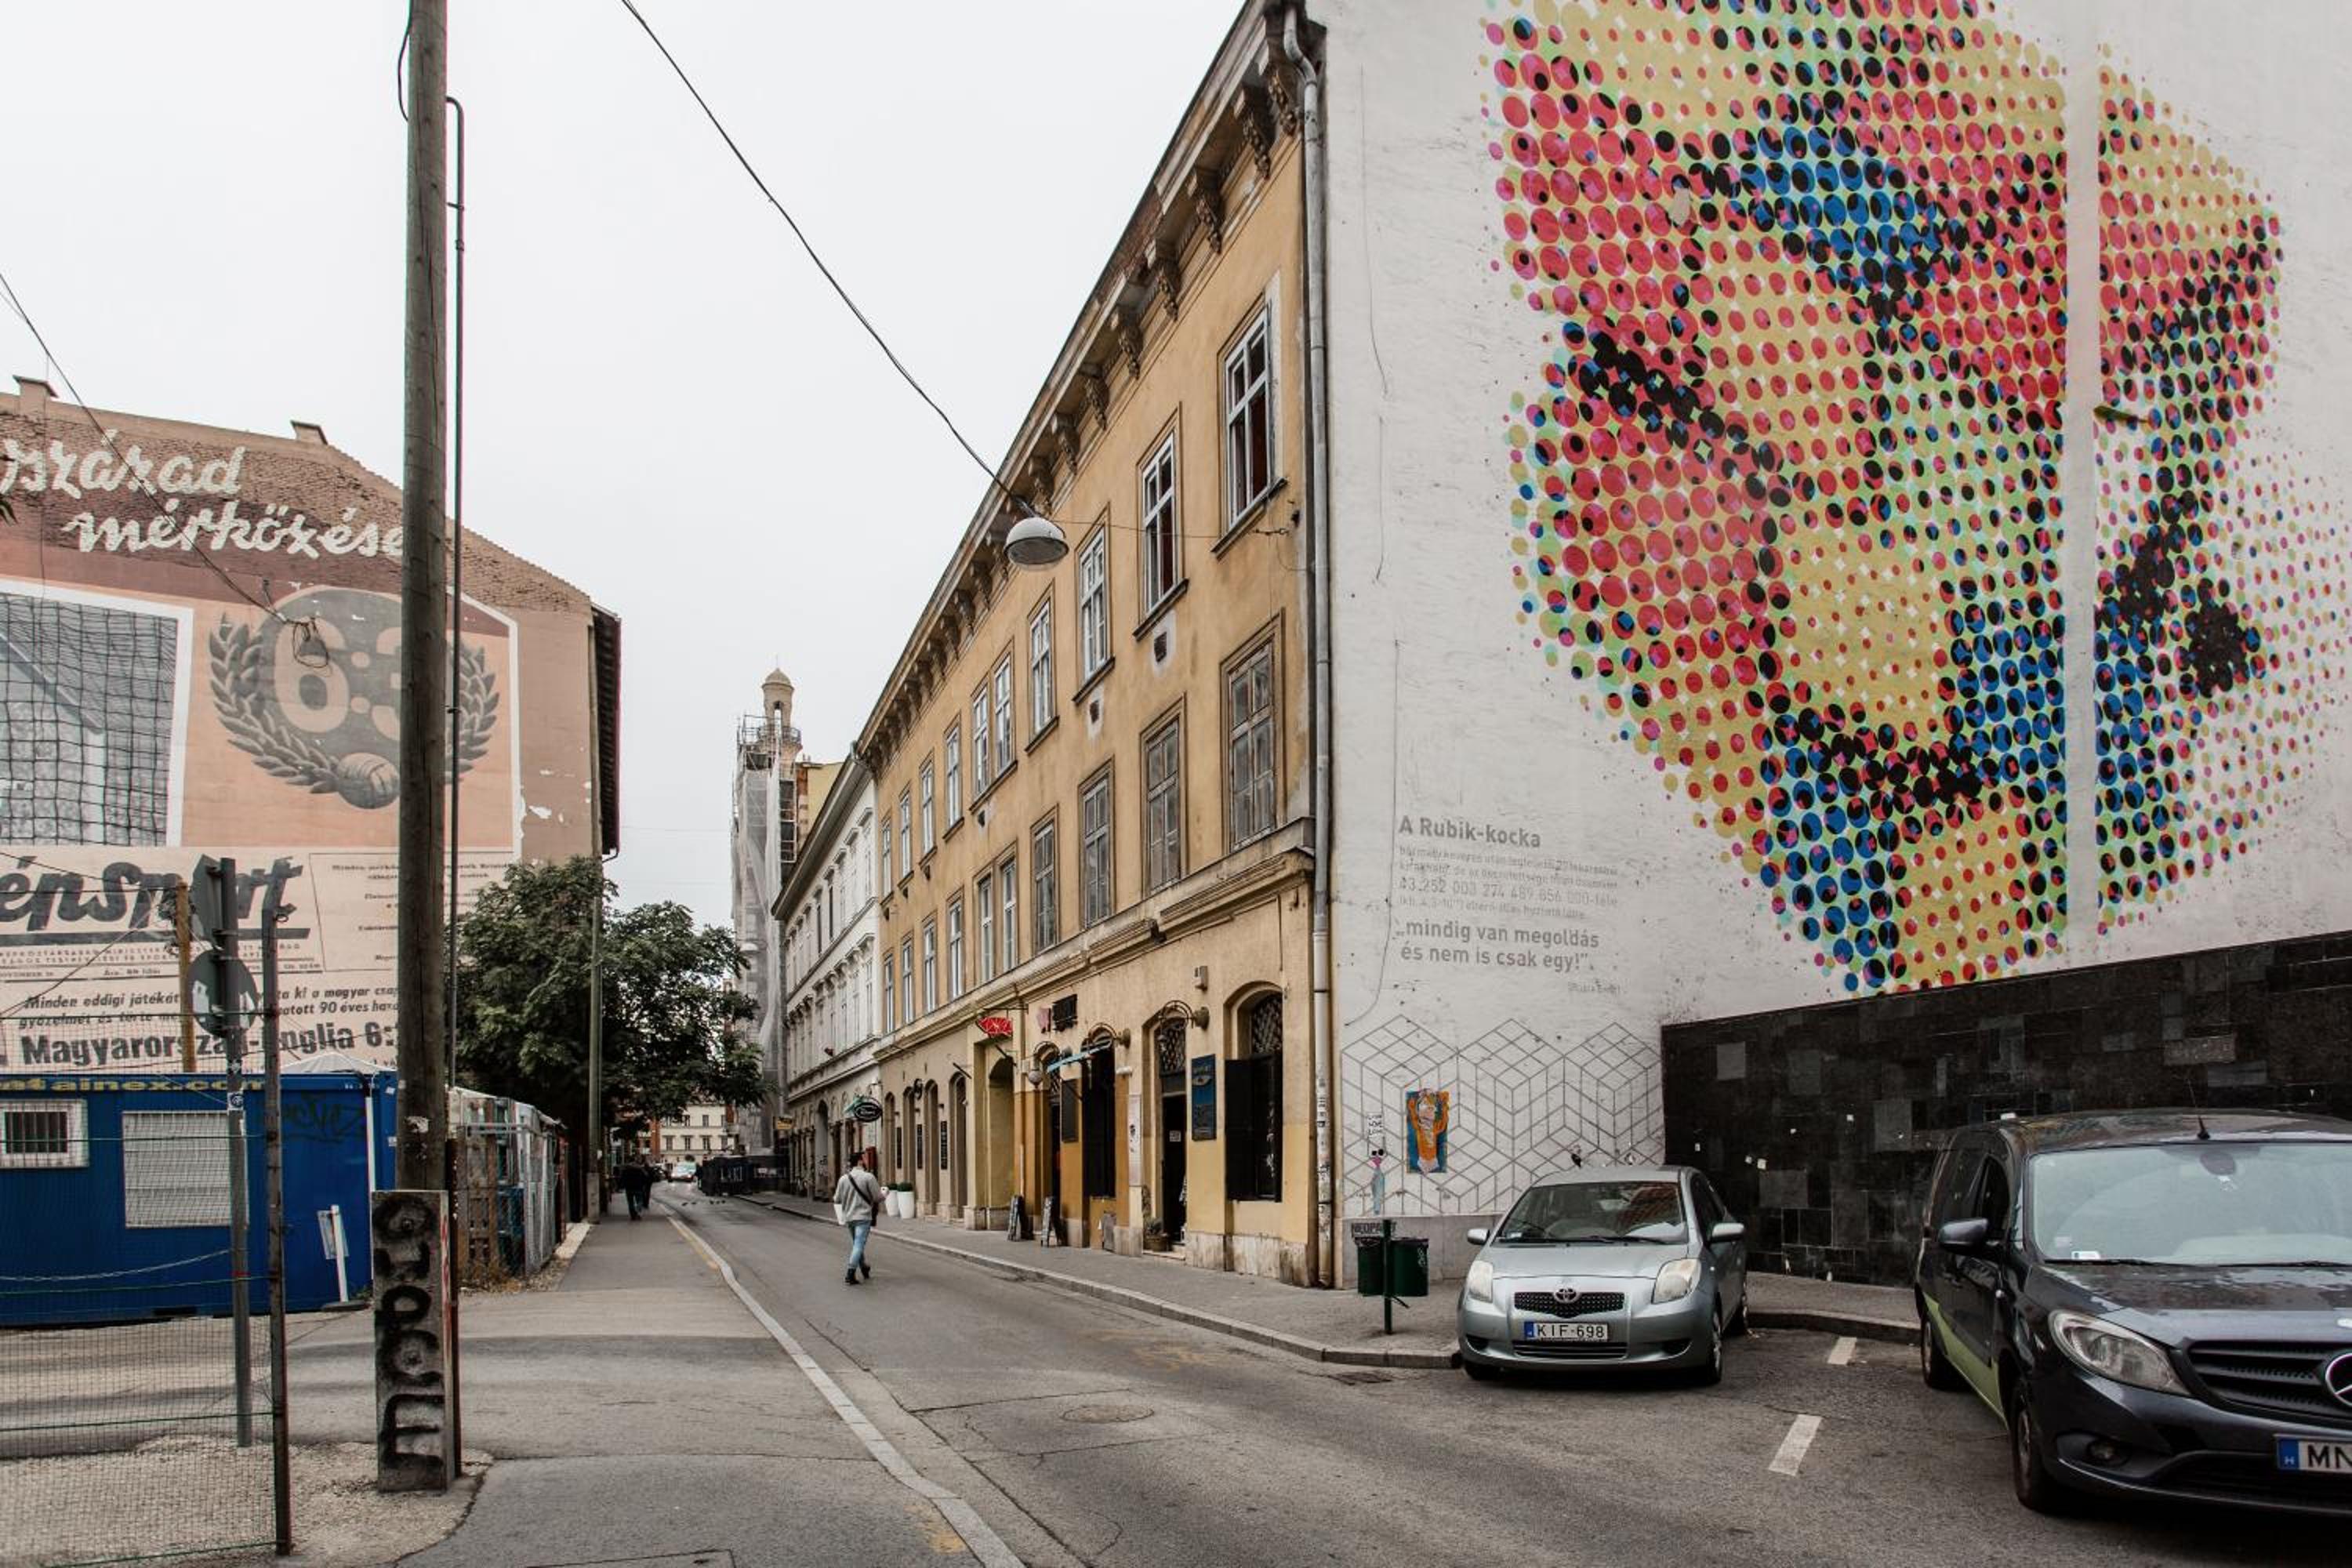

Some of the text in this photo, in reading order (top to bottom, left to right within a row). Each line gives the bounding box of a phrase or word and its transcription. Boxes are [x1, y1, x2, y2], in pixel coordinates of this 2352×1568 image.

[0, 429, 246, 500] század
[1398, 815, 1541, 848] A Rubik-kocka
[1477, 926, 1508, 942] van
[1514, 927, 1600, 949] megoldás
[1400, 942, 1424, 961] és
[1429, 947, 1469, 964] nem
[1475, 949, 1491, 965] is
[1496, 949, 1538, 967] csak
[323, 986, 370, 999] magyar
[319, 1001, 337, 1014] 90
[339, 1001, 369, 1014] éves
[365, 1021, 398, 1047] 6:
[1537, 1323, 1605, 1338] KIF-698
